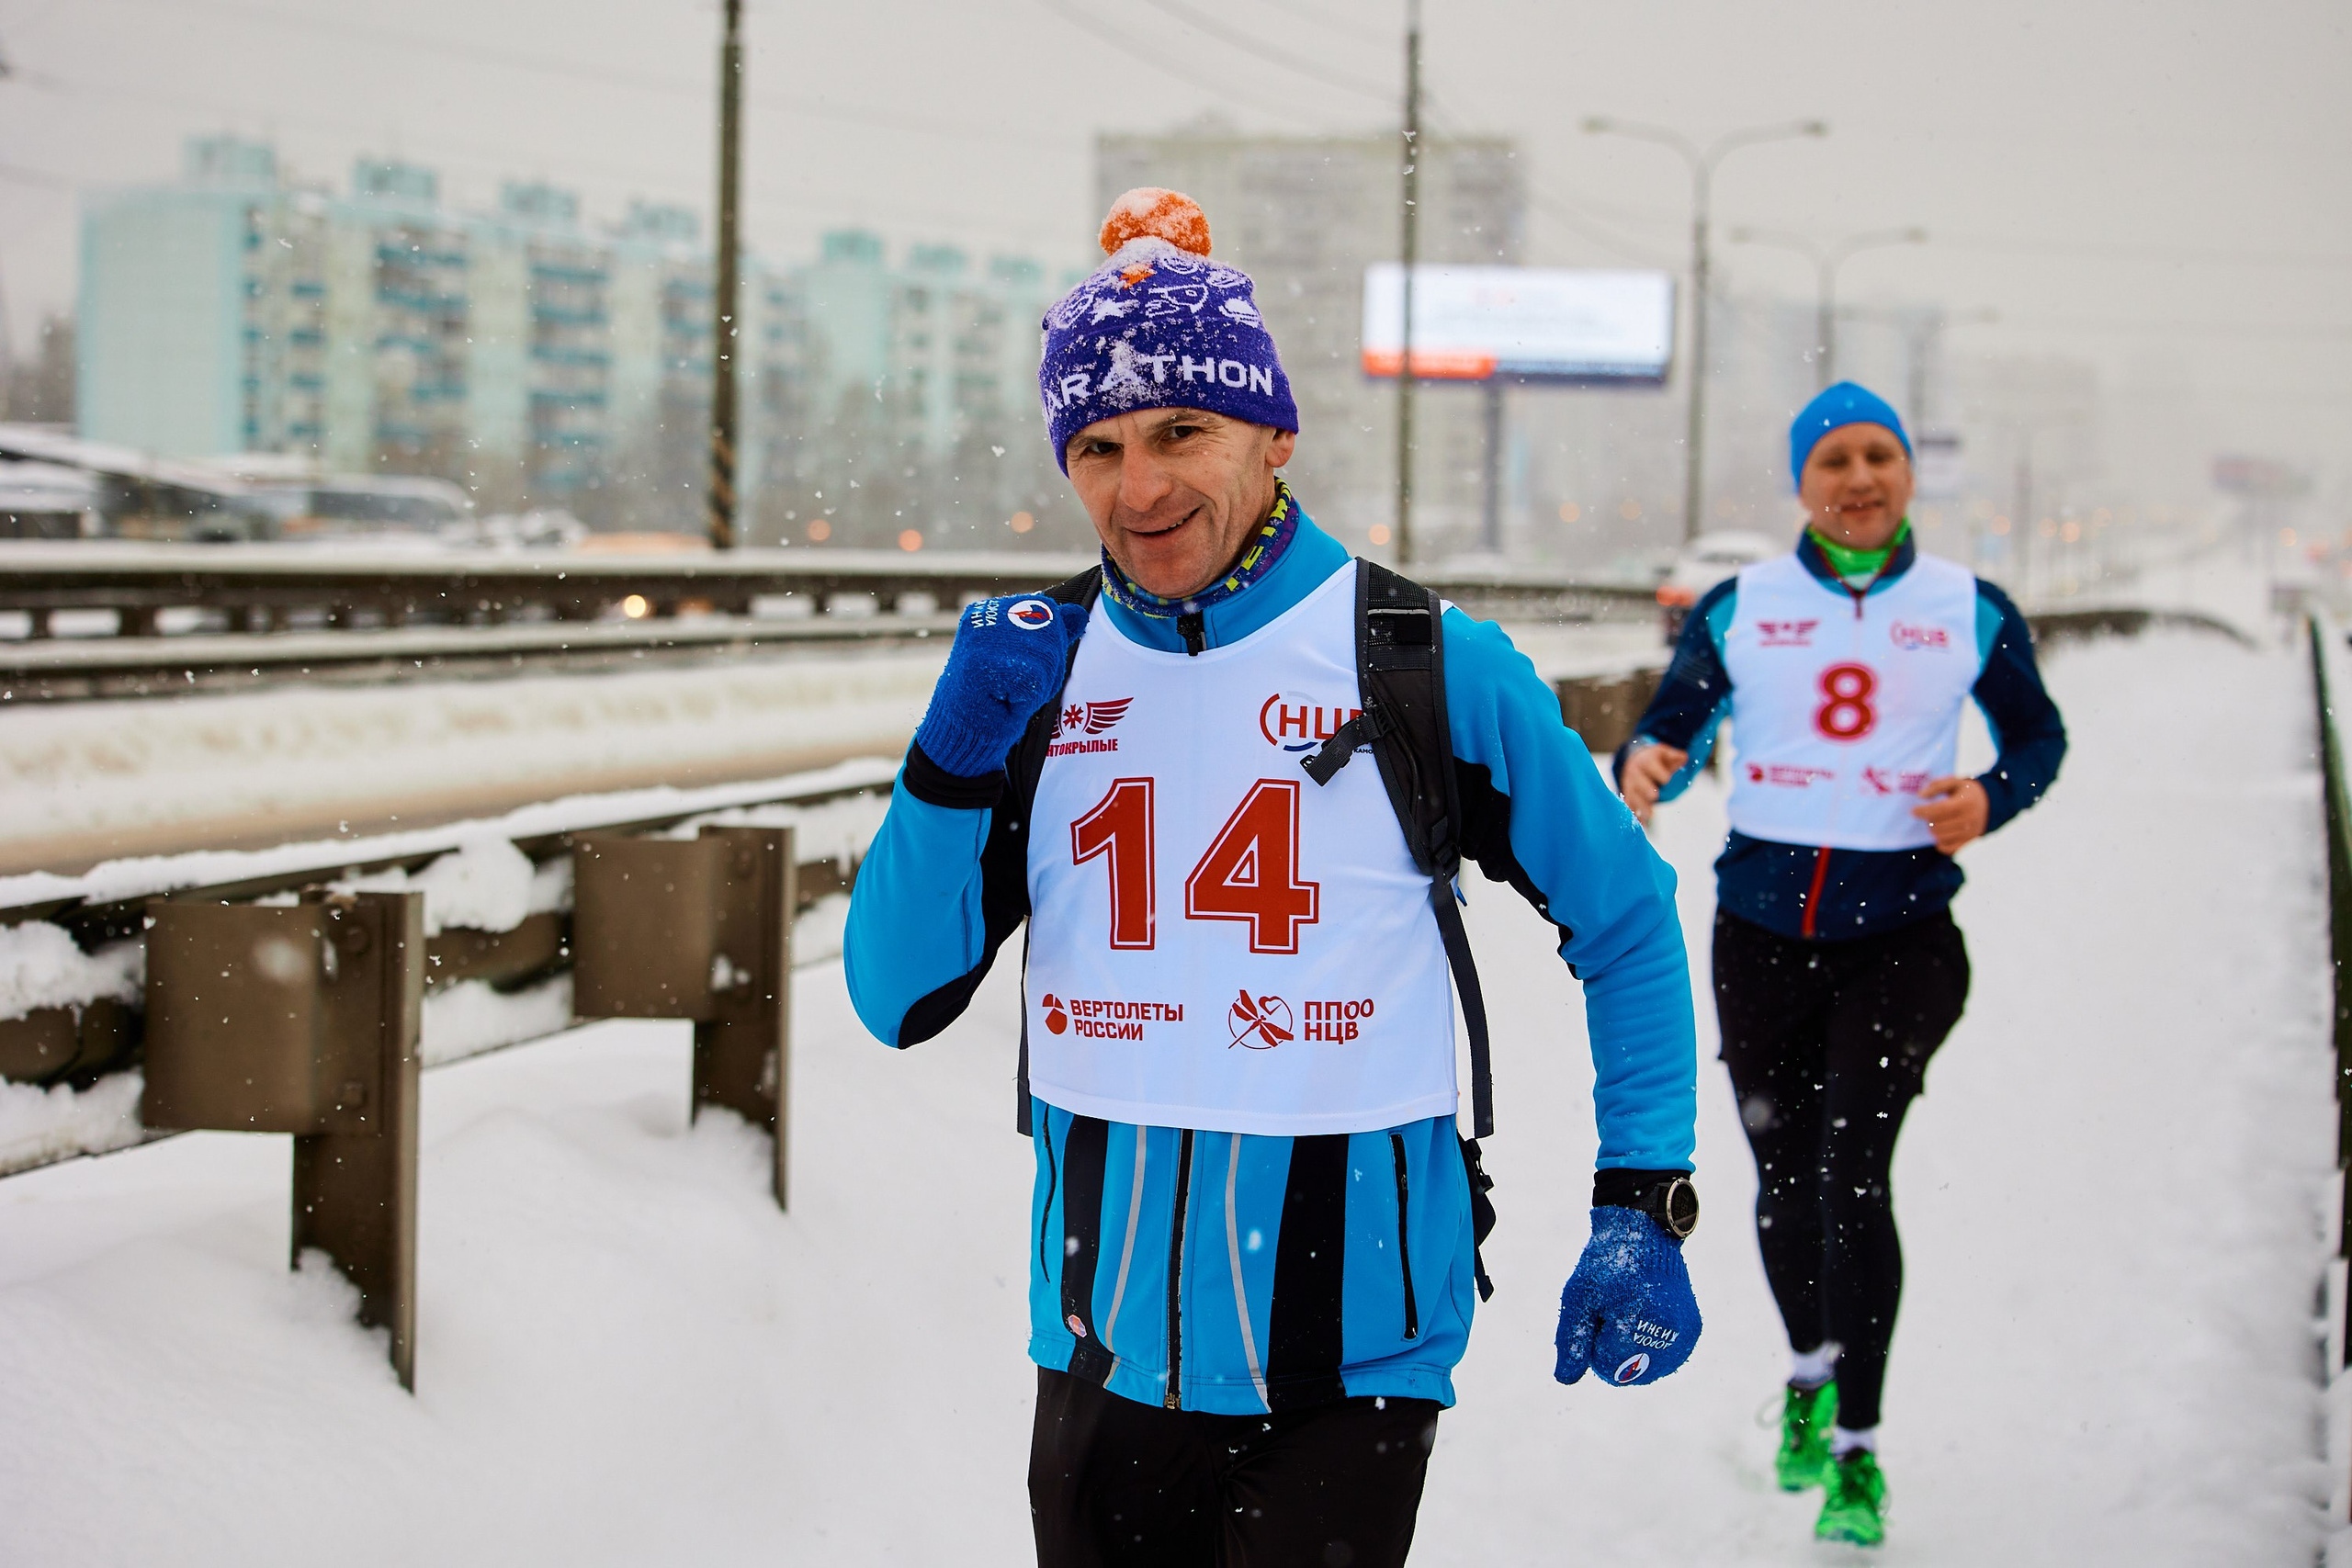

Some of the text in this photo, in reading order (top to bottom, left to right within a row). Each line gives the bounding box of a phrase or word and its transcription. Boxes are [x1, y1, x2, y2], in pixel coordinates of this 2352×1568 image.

[1045, 354, 1273, 423] ARATHON
[1815, 660, 1879, 742] 8
[1046, 739, 1118, 757] НТОКРЫЛЫЕ
[1070, 776, 1320, 954] 14
[1069, 999, 1183, 1021] ВЕРТОЛЕТЫ
[1074, 1019, 1144, 1041] РОССИИ
[1305, 1021, 1360, 1044] НЦВ
